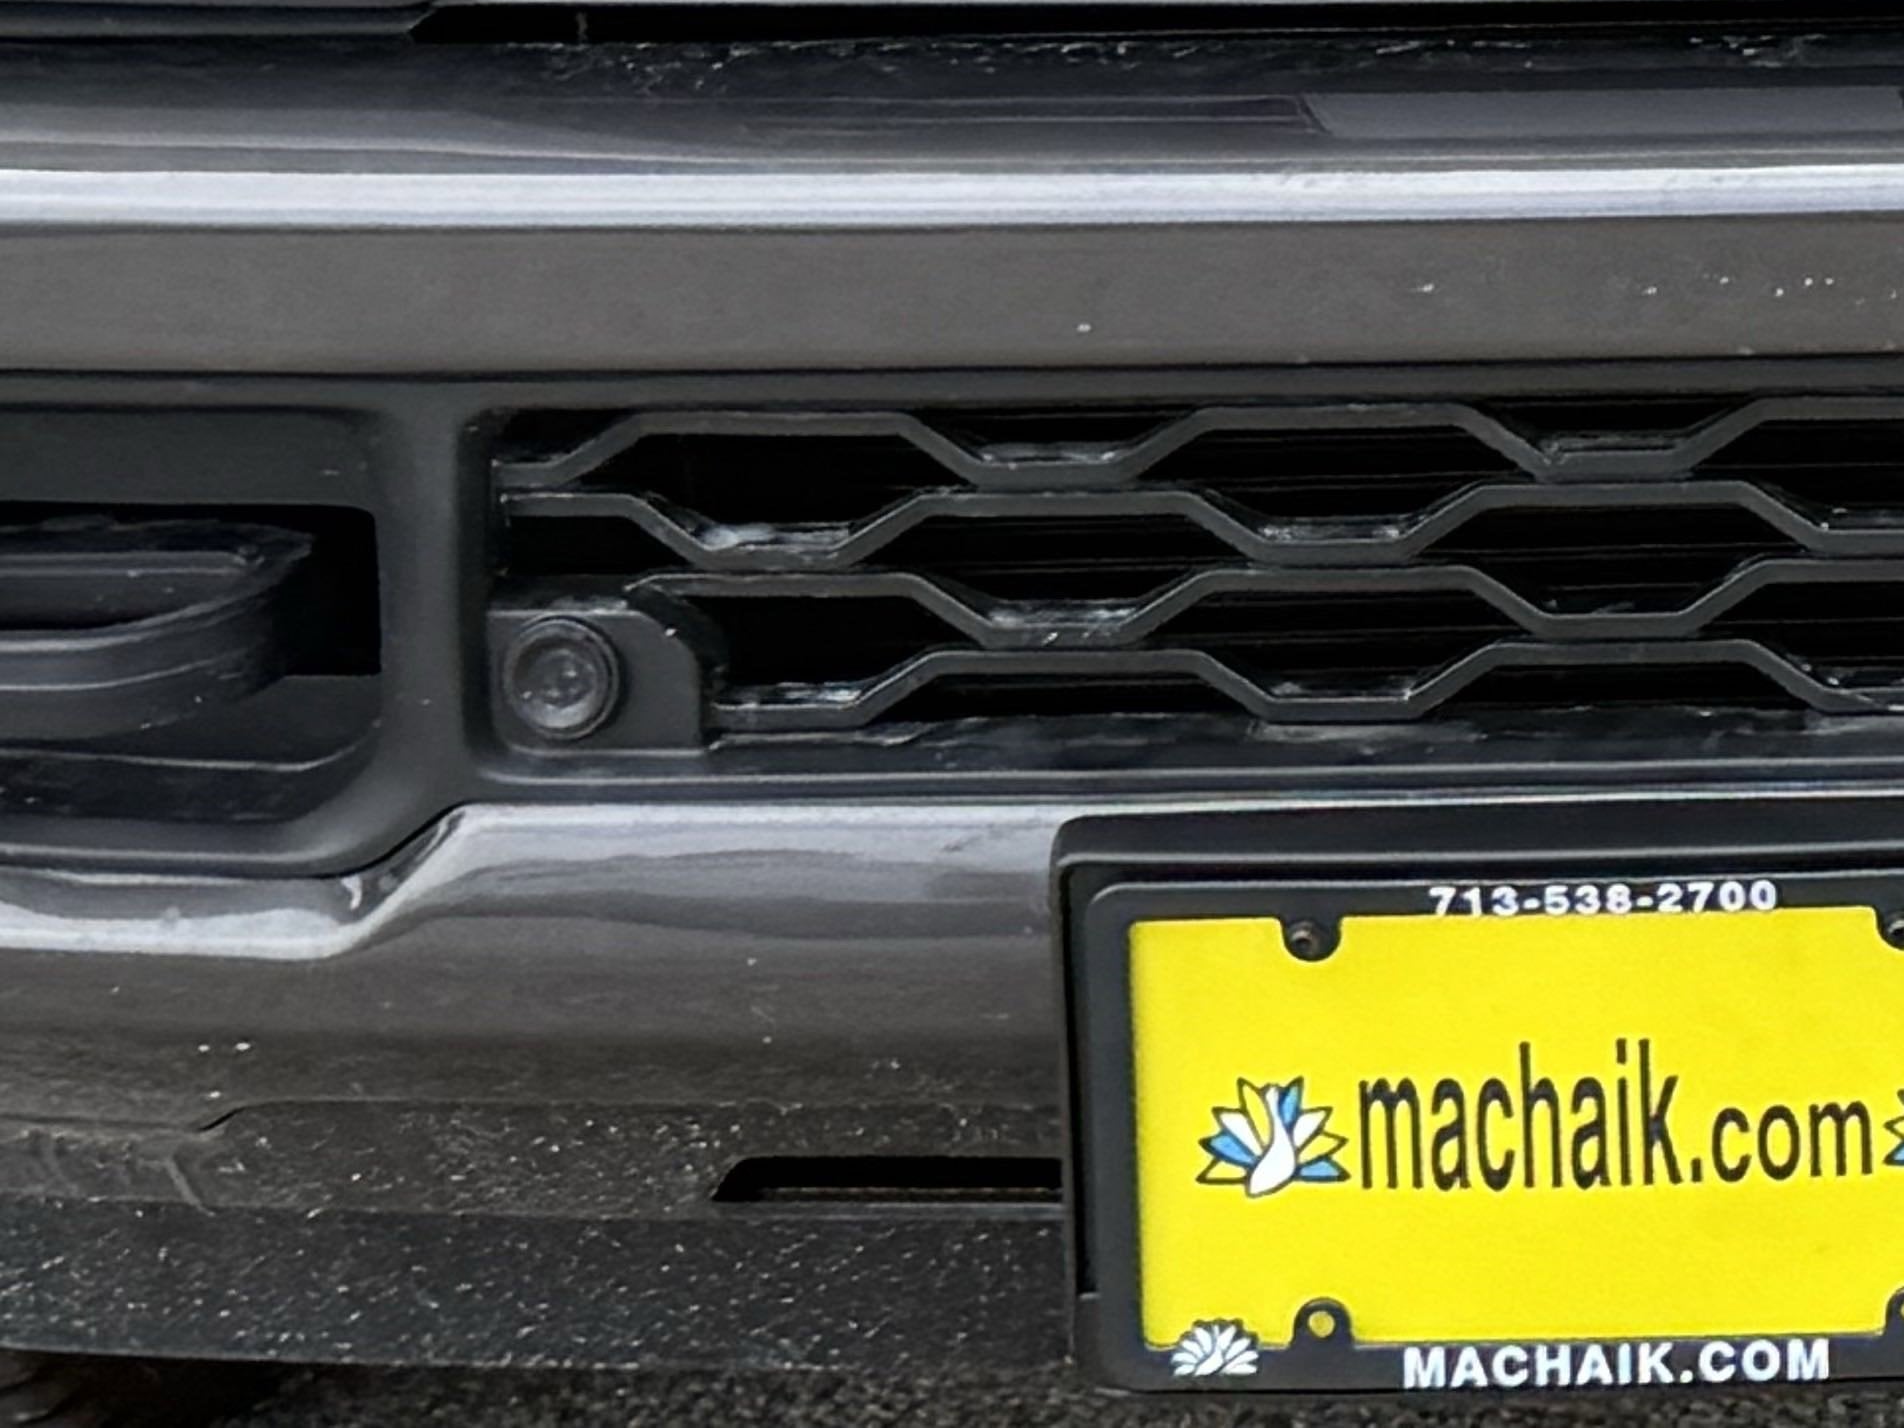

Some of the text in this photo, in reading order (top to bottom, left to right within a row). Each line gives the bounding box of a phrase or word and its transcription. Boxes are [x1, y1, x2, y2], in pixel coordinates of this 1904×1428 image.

[1428, 880, 1778, 918] 713-538-2700
[1358, 1038, 1873, 1192] machaik.com
[1402, 1338, 1831, 1389] MACHAIK.COM
